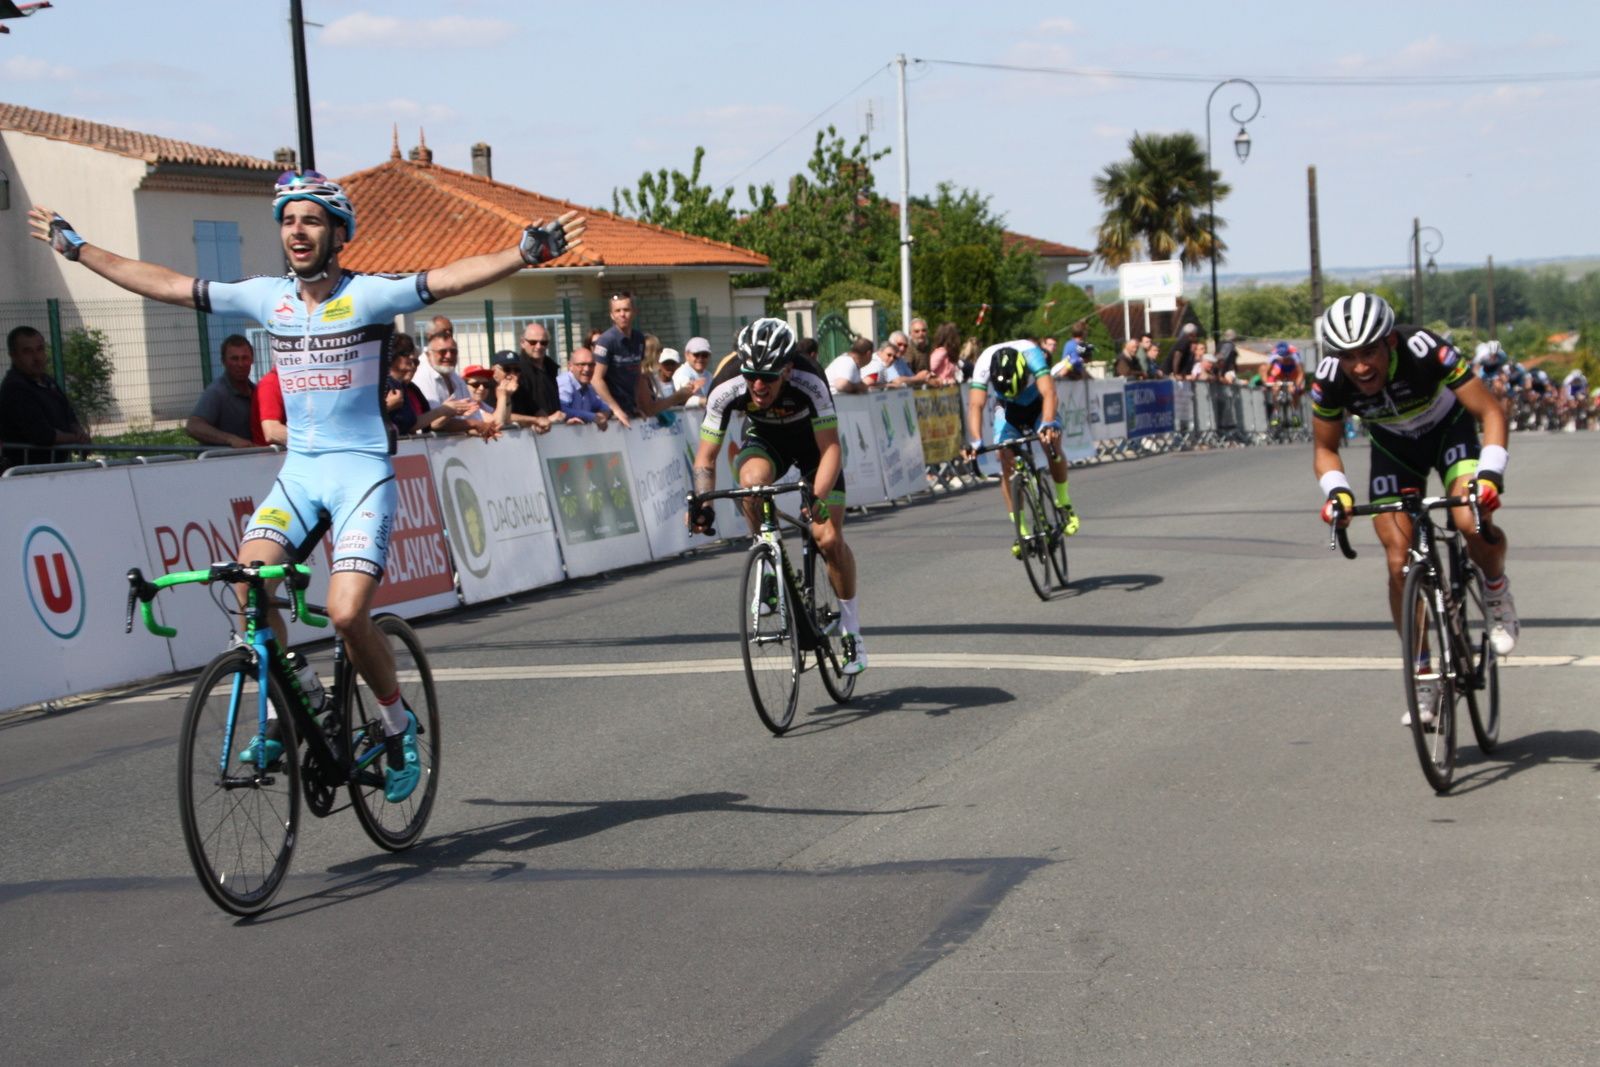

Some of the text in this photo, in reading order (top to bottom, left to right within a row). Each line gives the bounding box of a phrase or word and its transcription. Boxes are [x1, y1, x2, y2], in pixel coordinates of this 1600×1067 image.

[279, 349, 359, 366] arie Morin
[1407, 330, 1437, 358] 01
[1315, 356, 1340, 382] 01
[1444, 443, 1468, 465] 01
[1372, 474, 1398, 495] 01
[487, 491, 549, 532] DAGNAUD
[386, 533, 446, 584] BLAYAIS
[33, 553, 72, 615] U
